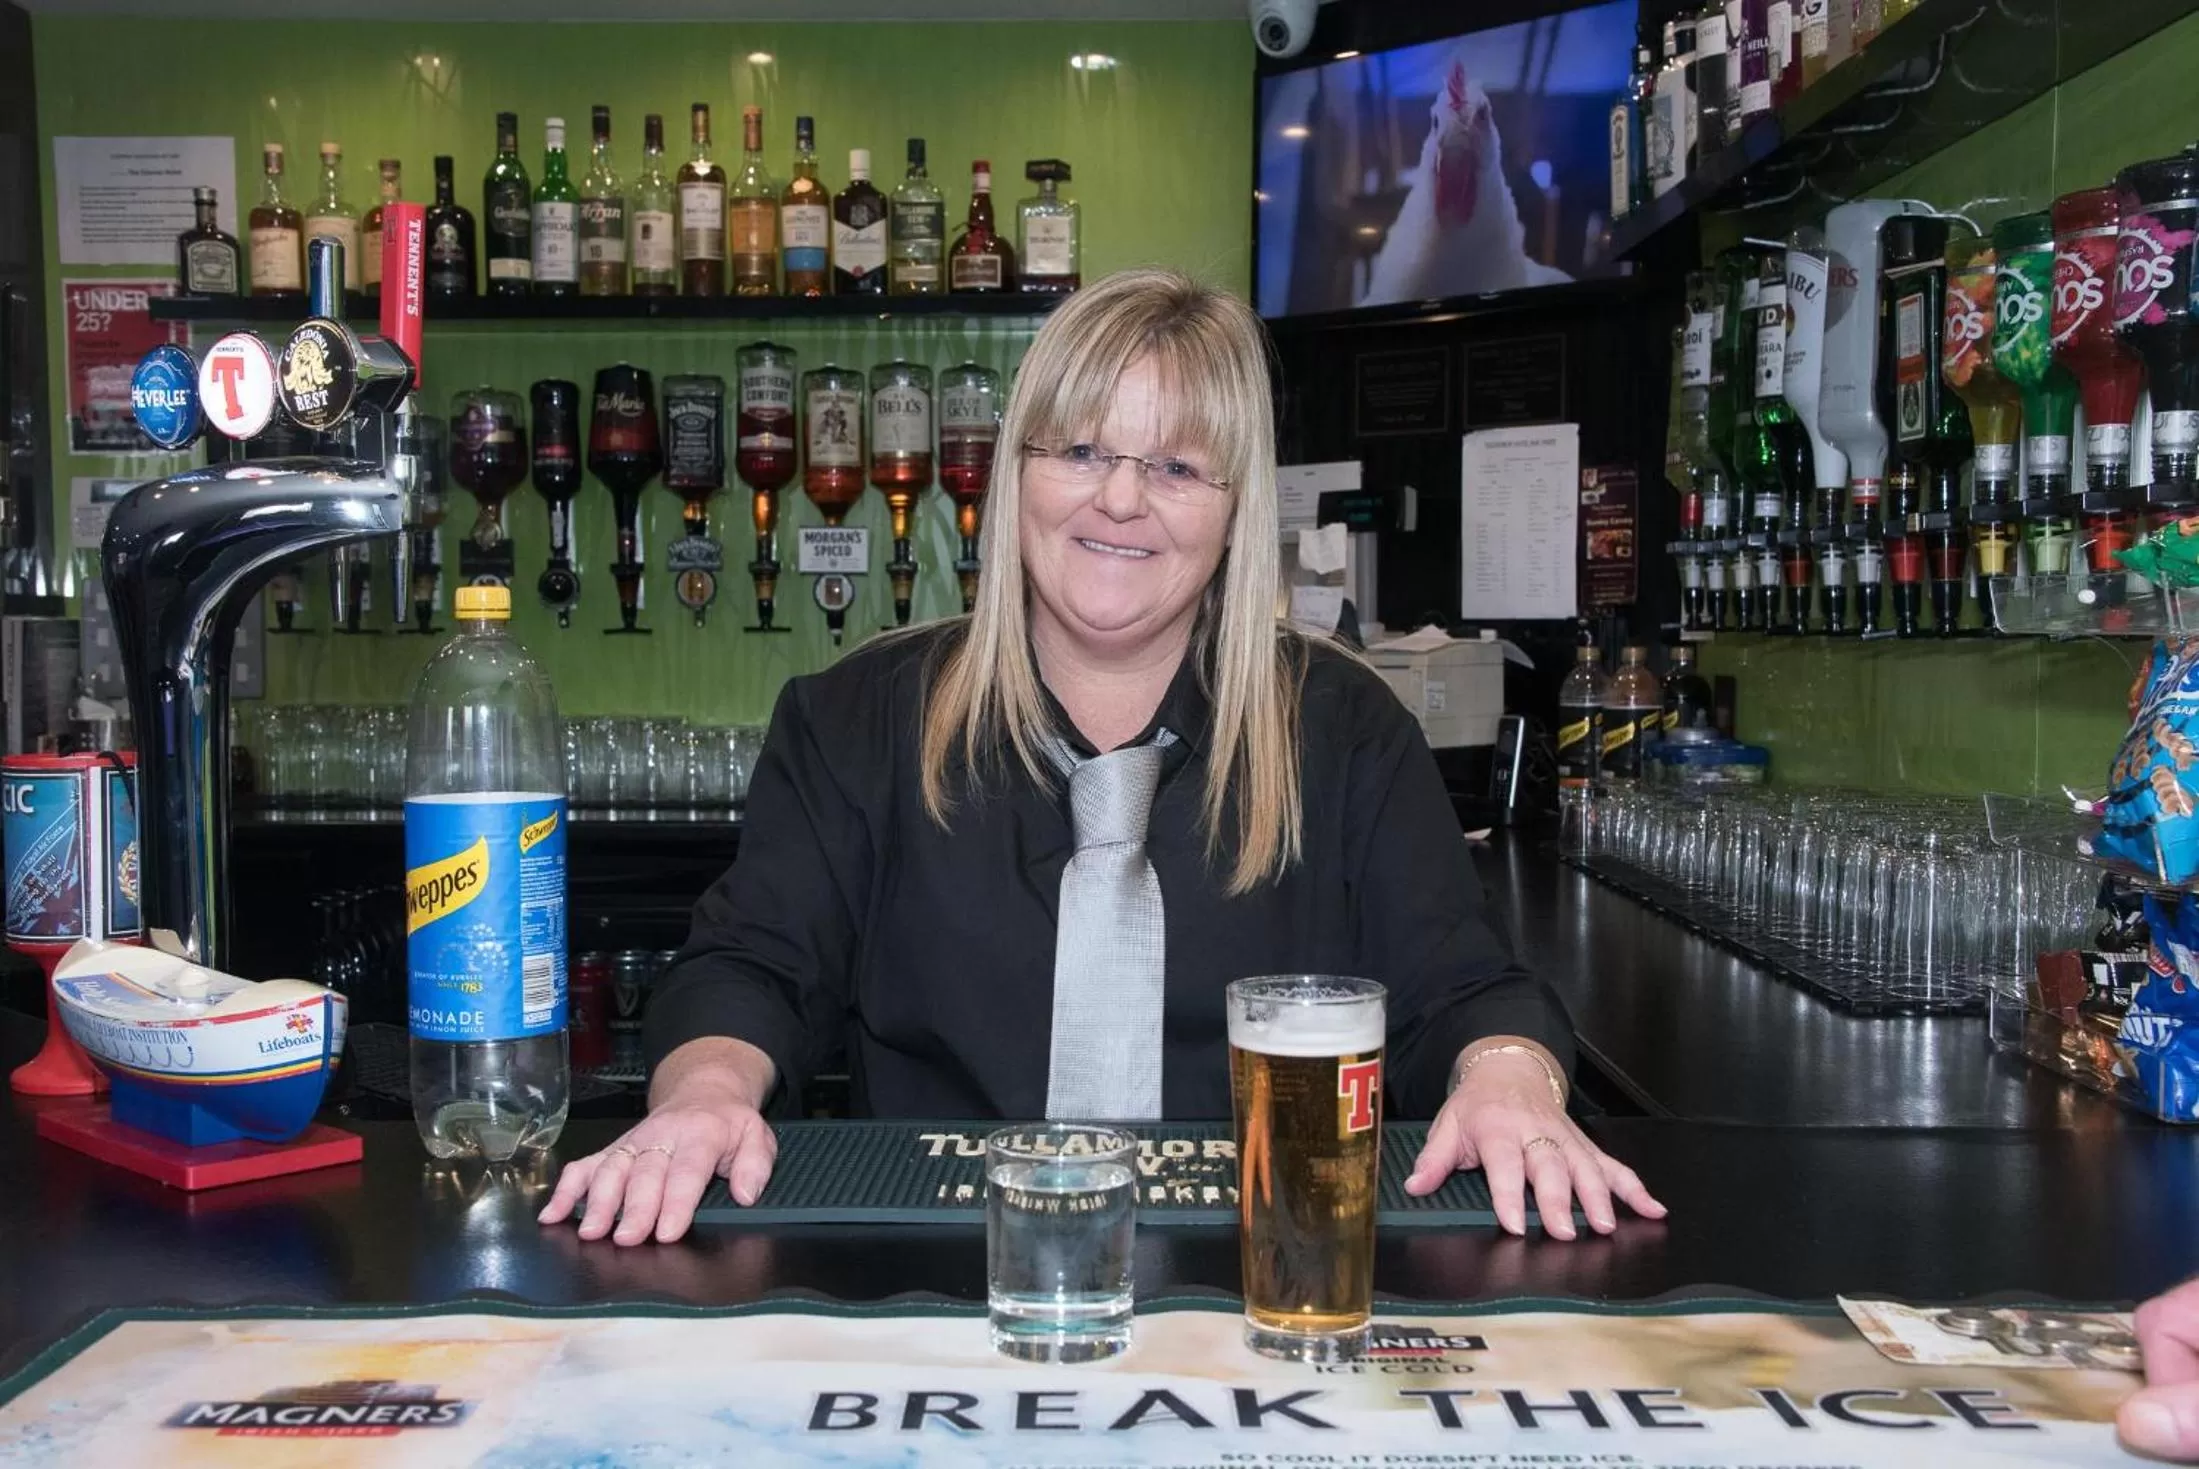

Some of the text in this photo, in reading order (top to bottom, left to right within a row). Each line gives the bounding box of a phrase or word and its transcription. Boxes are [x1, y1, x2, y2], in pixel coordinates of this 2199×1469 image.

[406, 219, 421, 317] TENNENT'S
[75, 290, 149, 311] UNDER
[76, 312, 112, 332] 25?
[284, 328, 330, 363] CALEDONIA
[131, 384, 187, 412] HEVERLEE
[212, 356, 245, 421] T
[294, 389, 328, 411] BEST
[878, 399, 922, 416] BELL'S
[804, 530, 862, 545] MORGAN'S
[813, 545, 853, 557] SPICED
[402, 861, 480, 915] weppes
[258, 1033, 322, 1054] Lifeboats
[1338, 1058, 1381, 1132] T
[919, 1133, 1238, 1159] TULLAMOR
[1372, 1336, 1472, 1348] NERS
[1314, 1364, 1475, 1375] ICE COLD
[184, 1402, 461, 1424] MAGNERS
[806, 1388, 2042, 1431] BREAK THE ICE
[1220, 1453, 1257, 1462] SO
[1266, 1453, 1343, 1463] COOL
[1351, 1454, 1373, 1463] IT
[1383, 1454, 1499, 1463] DOESN'T
[1508, 1454, 1583, 1463] NEED
